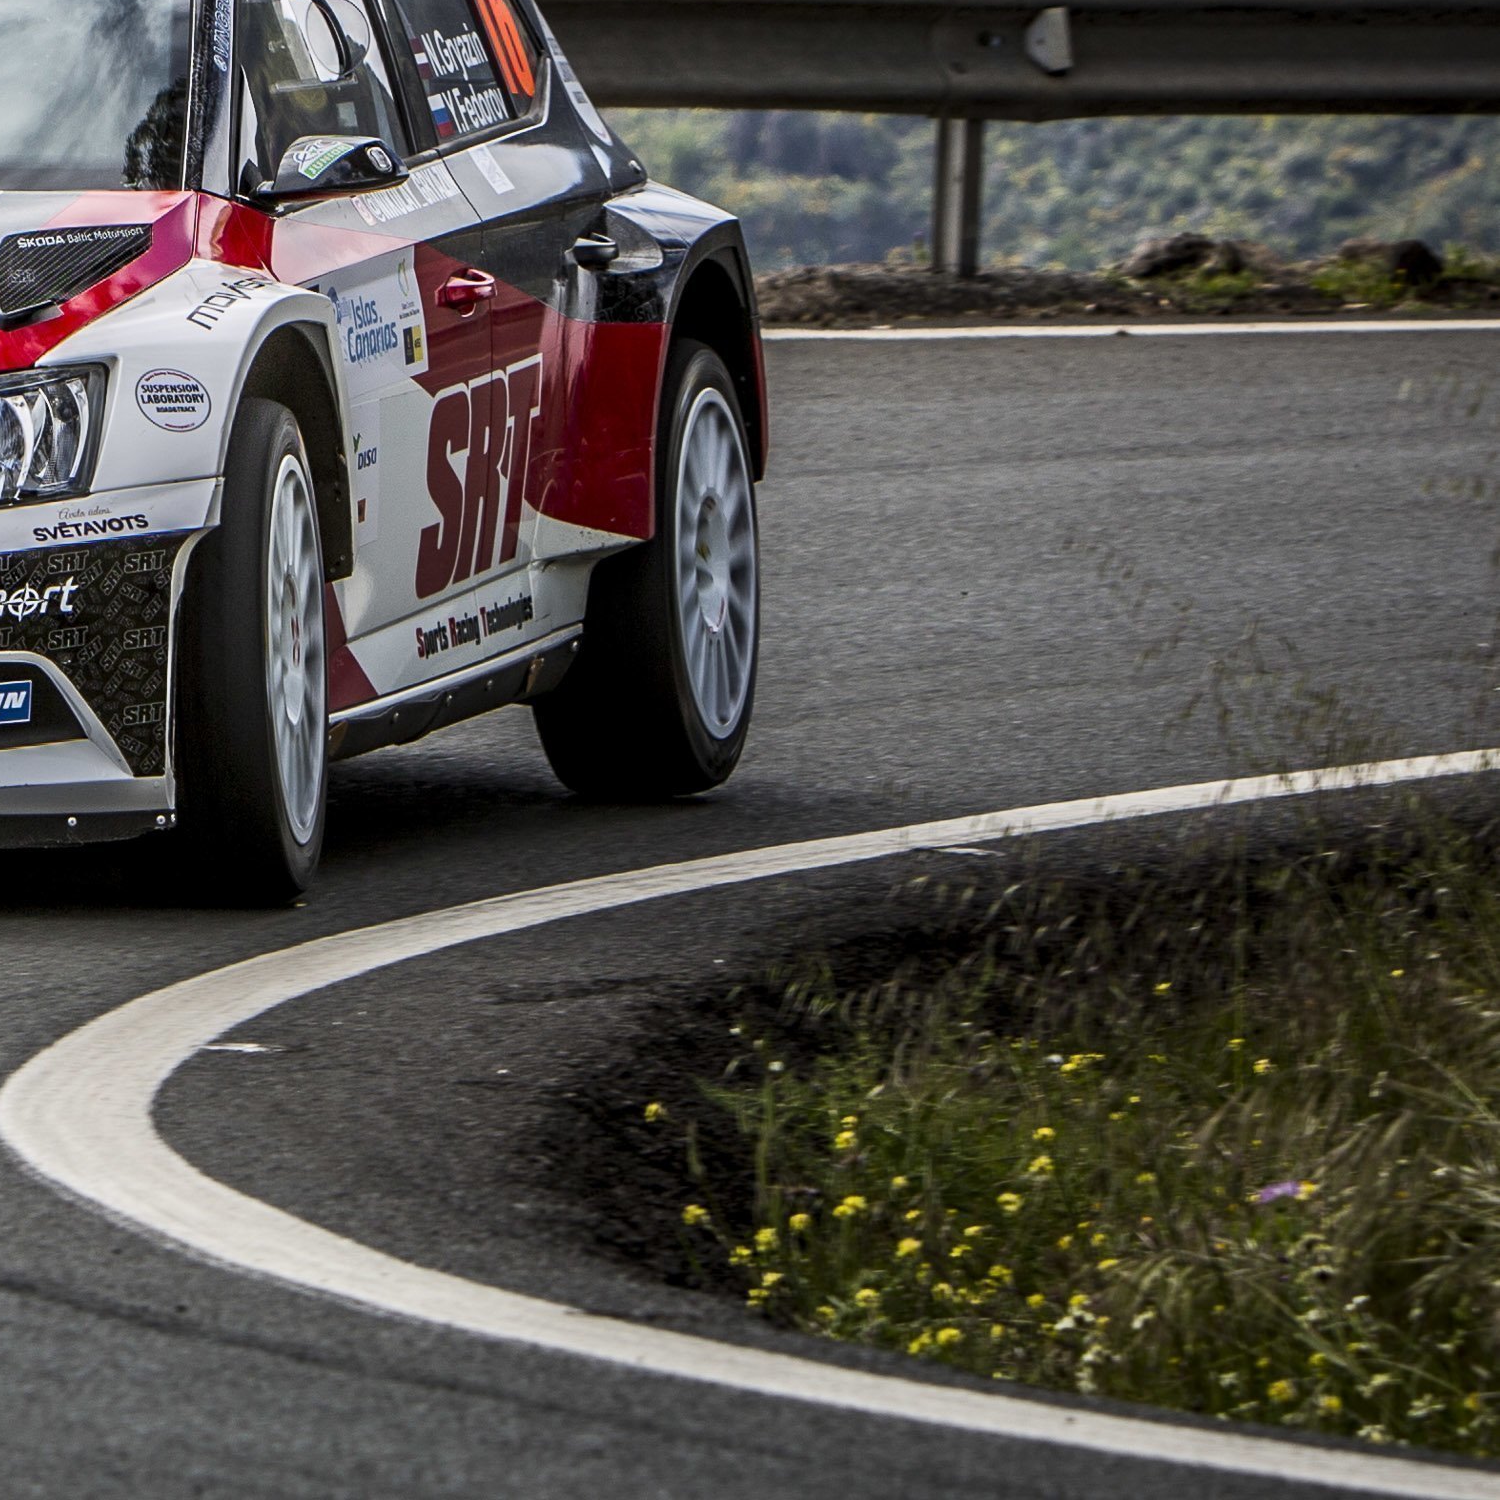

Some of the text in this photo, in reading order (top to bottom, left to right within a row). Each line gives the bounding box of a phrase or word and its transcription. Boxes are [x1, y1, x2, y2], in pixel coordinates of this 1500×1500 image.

[421, 22, 489, 81] N.Gryazin
[441, 84, 510, 134] Y.Fedorov
[67, 232, 94, 244] Baltic
[350, 295, 379, 330] Islas
[347, 321, 399, 364] Canarias
[140, 393, 205, 405] LABORATORY
[141, 383, 200, 394] SUSPENSION
[415, 354, 543, 599] SRT
[33, 513, 150, 542] SVĒTAVOTS
[47, 550, 90, 575] SRT
[124, 550, 166, 574] SRT
[47, 625, 89, 651] SRT
[123, 625, 166, 650] SRT
[415, 620, 450, 660] Sports
[448, 612, 482, 646] Racing
[123, 702, 165, 726] SRT
